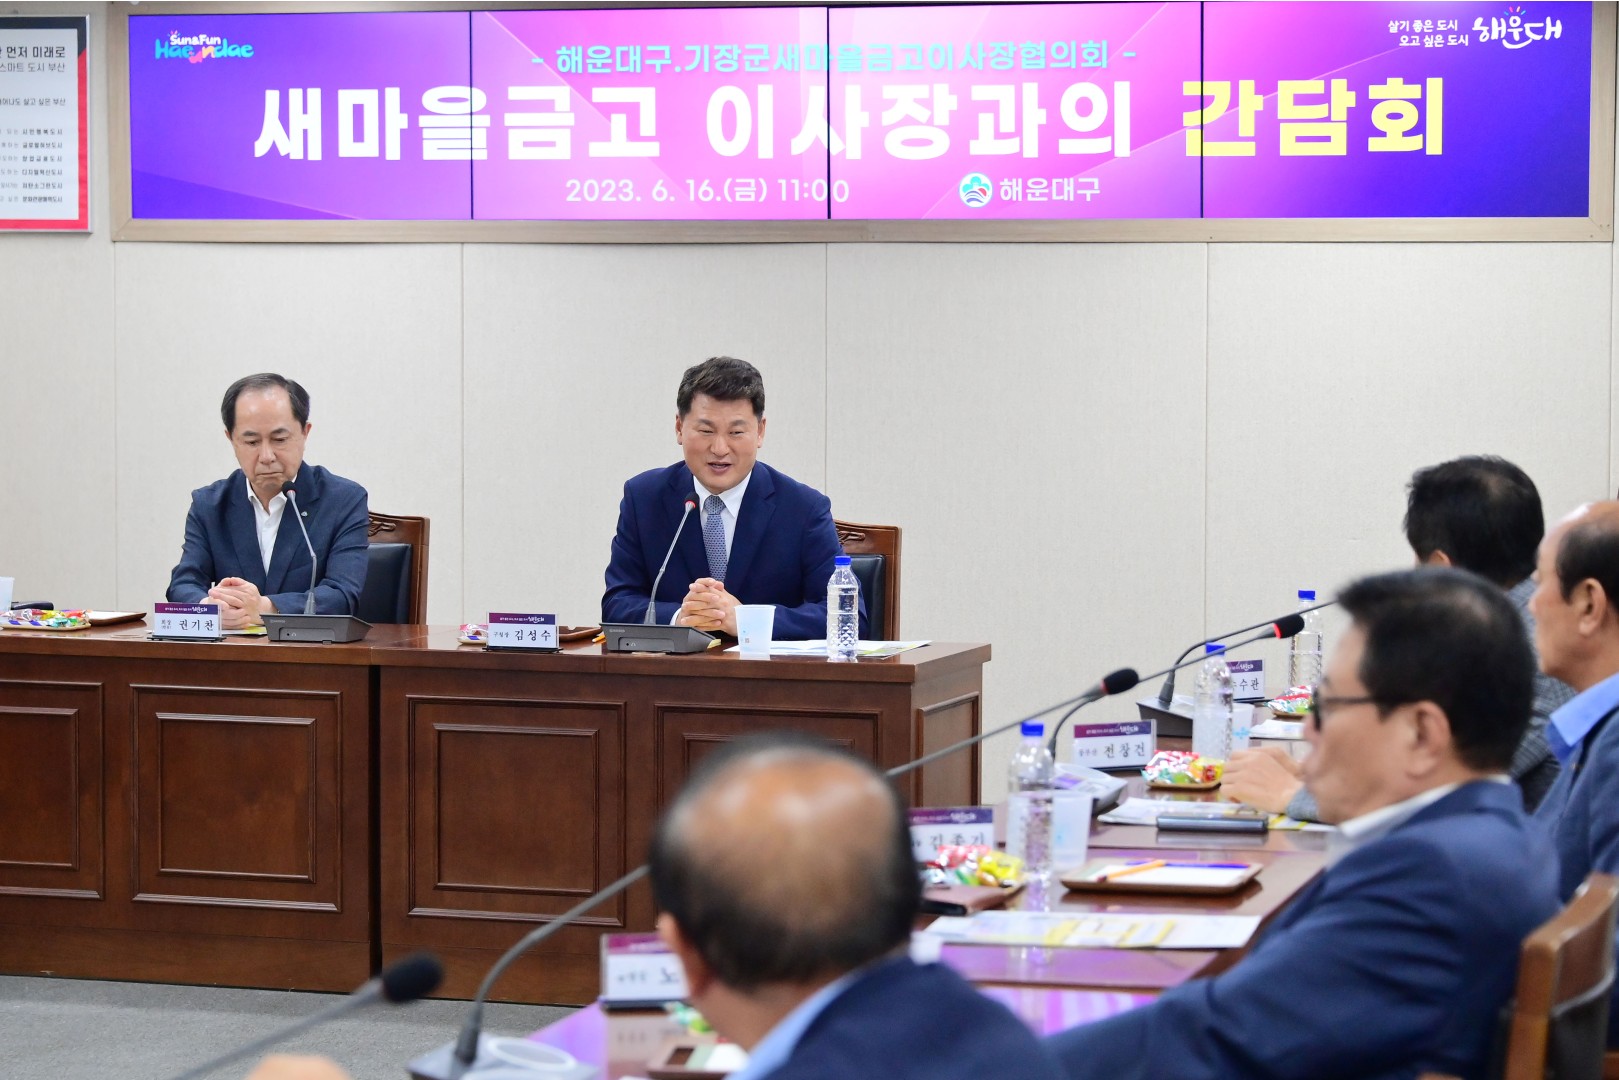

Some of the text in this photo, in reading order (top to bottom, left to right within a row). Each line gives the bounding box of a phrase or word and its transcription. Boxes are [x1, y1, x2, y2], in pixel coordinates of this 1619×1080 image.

[1388, 19, 1458, 33] 살기 좋은 도시
[1472, 15, 1563, 50] 해운대
[169, 33, 222, 46] Sun&Fun
[1399, 34, 1469, 48] 오고 싶은 도시
[6, 46, 28, 59] 먼저
[32, 46, 66, 58] 미래로
[556, 39, 1109, 75] 해운대구.기장군새마을금고이사장협의회
[28, 62, 45, 73] 도시
[48, 62, 66, 73] 부산
[0, 98, 21, 106] 어나도
[254, 77, 1444, 162] 새마을금고 이사장과의 간담회
[565, 177, 850, 203] 2023. 6. 16.(금) 11:00
[1000, 177, 1101, 202] 해운대구
[179, 619, 214, 631] 권기찬
[514, 629, 551, 641] 김성수
